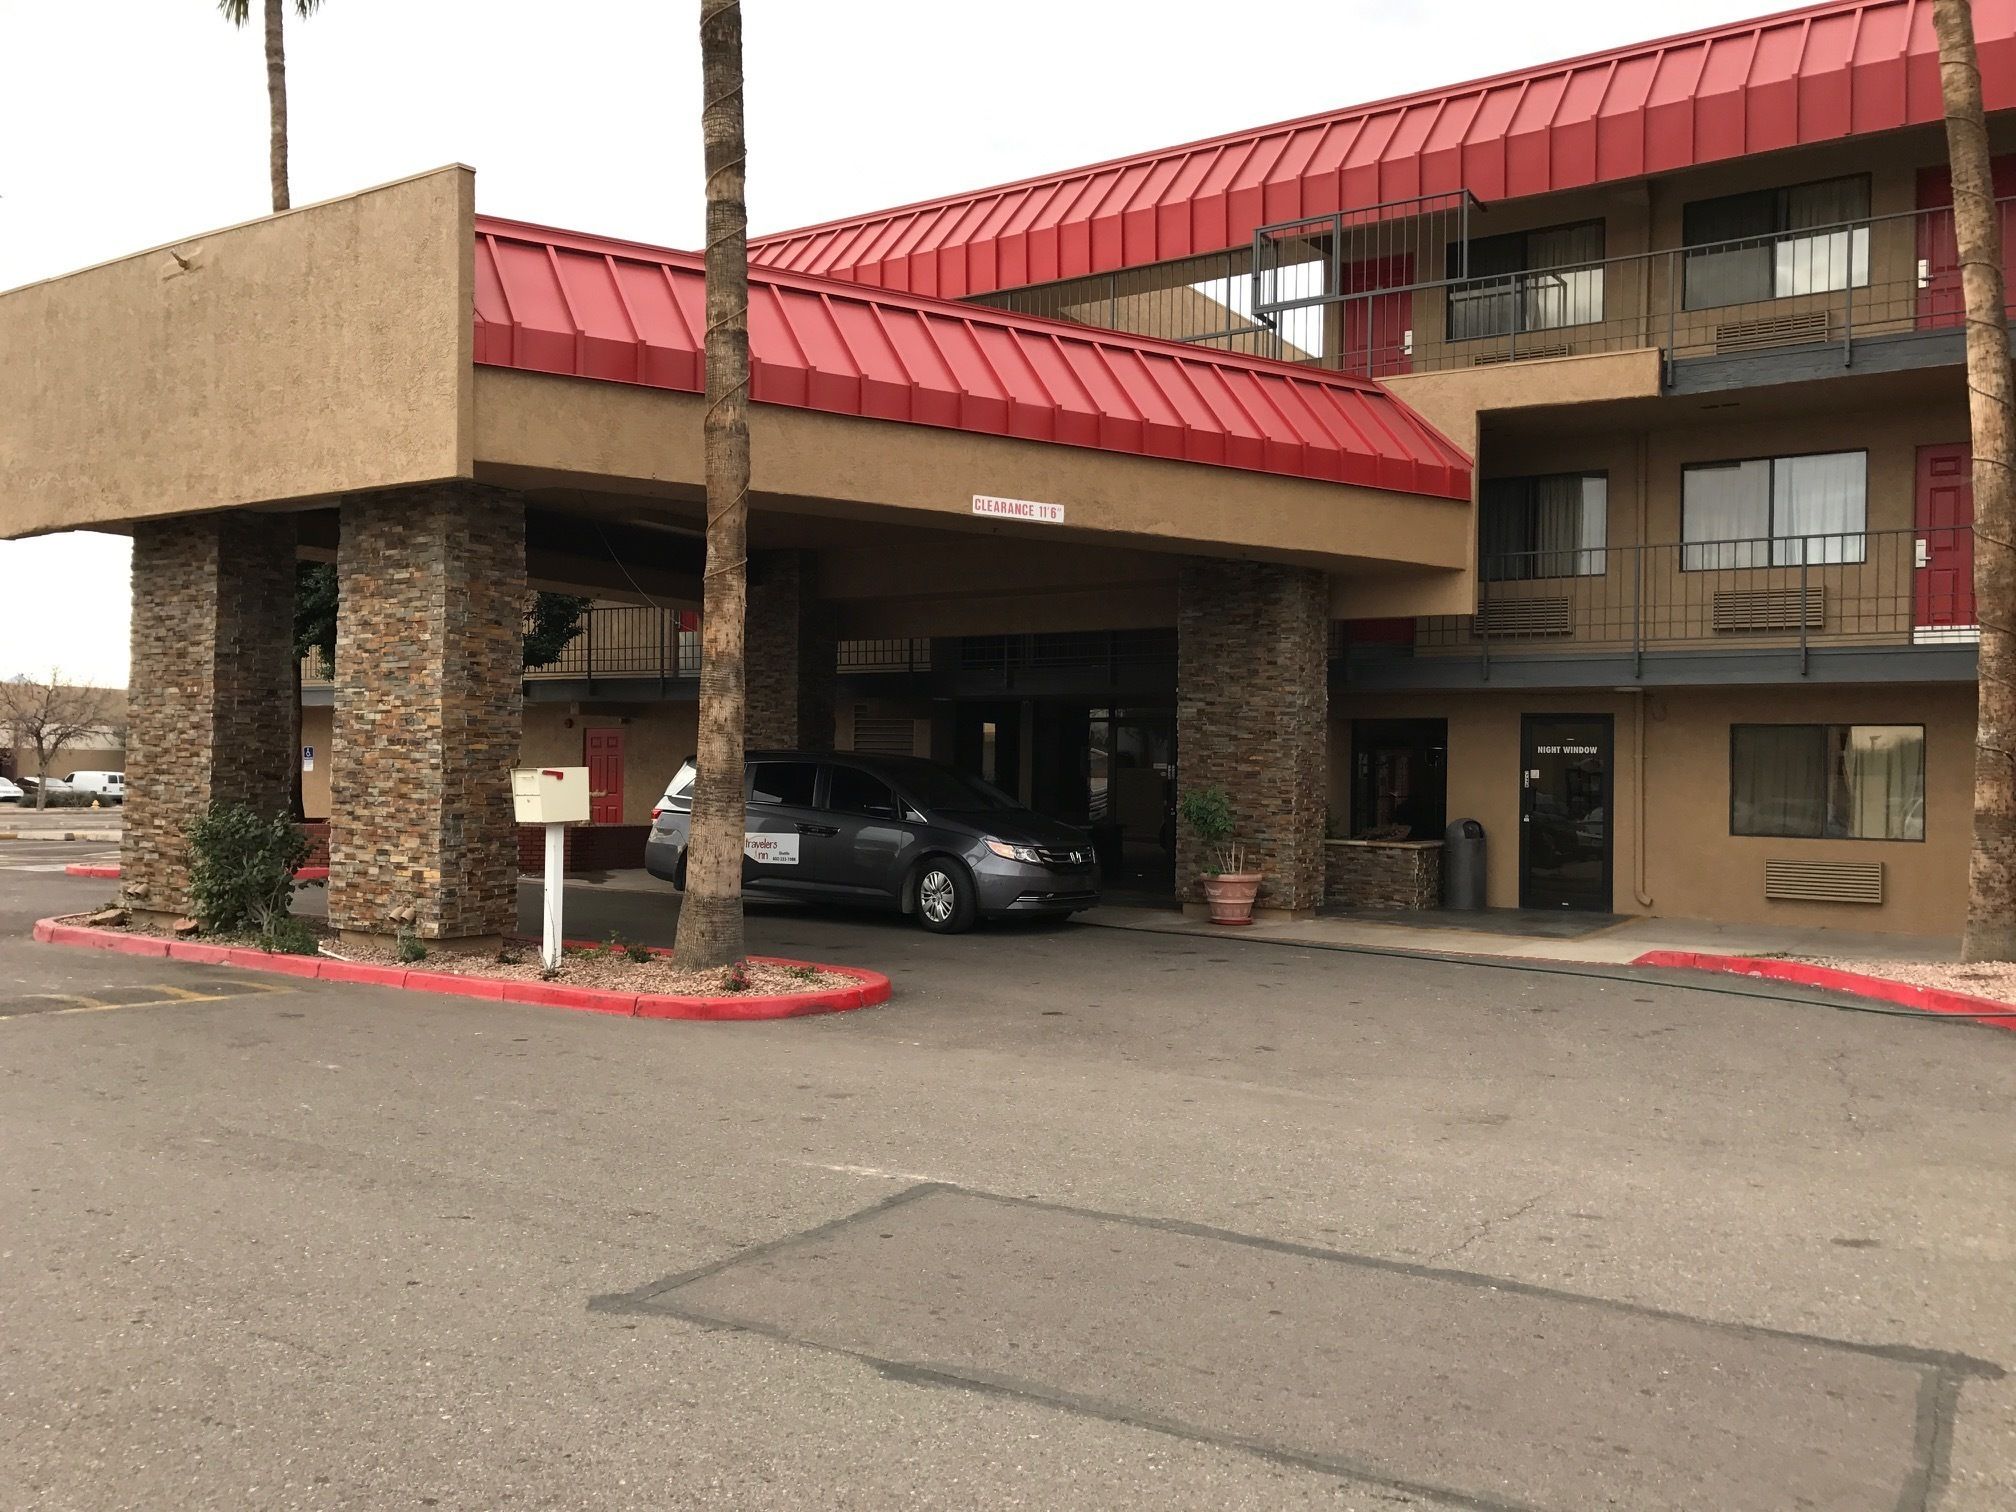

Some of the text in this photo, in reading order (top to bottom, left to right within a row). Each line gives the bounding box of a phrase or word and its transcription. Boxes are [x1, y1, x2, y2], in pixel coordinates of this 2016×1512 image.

[974, 498, 1035, 516] CLEARANCE
[1537, 745, 1598, 754] NIGHT WINDOW
